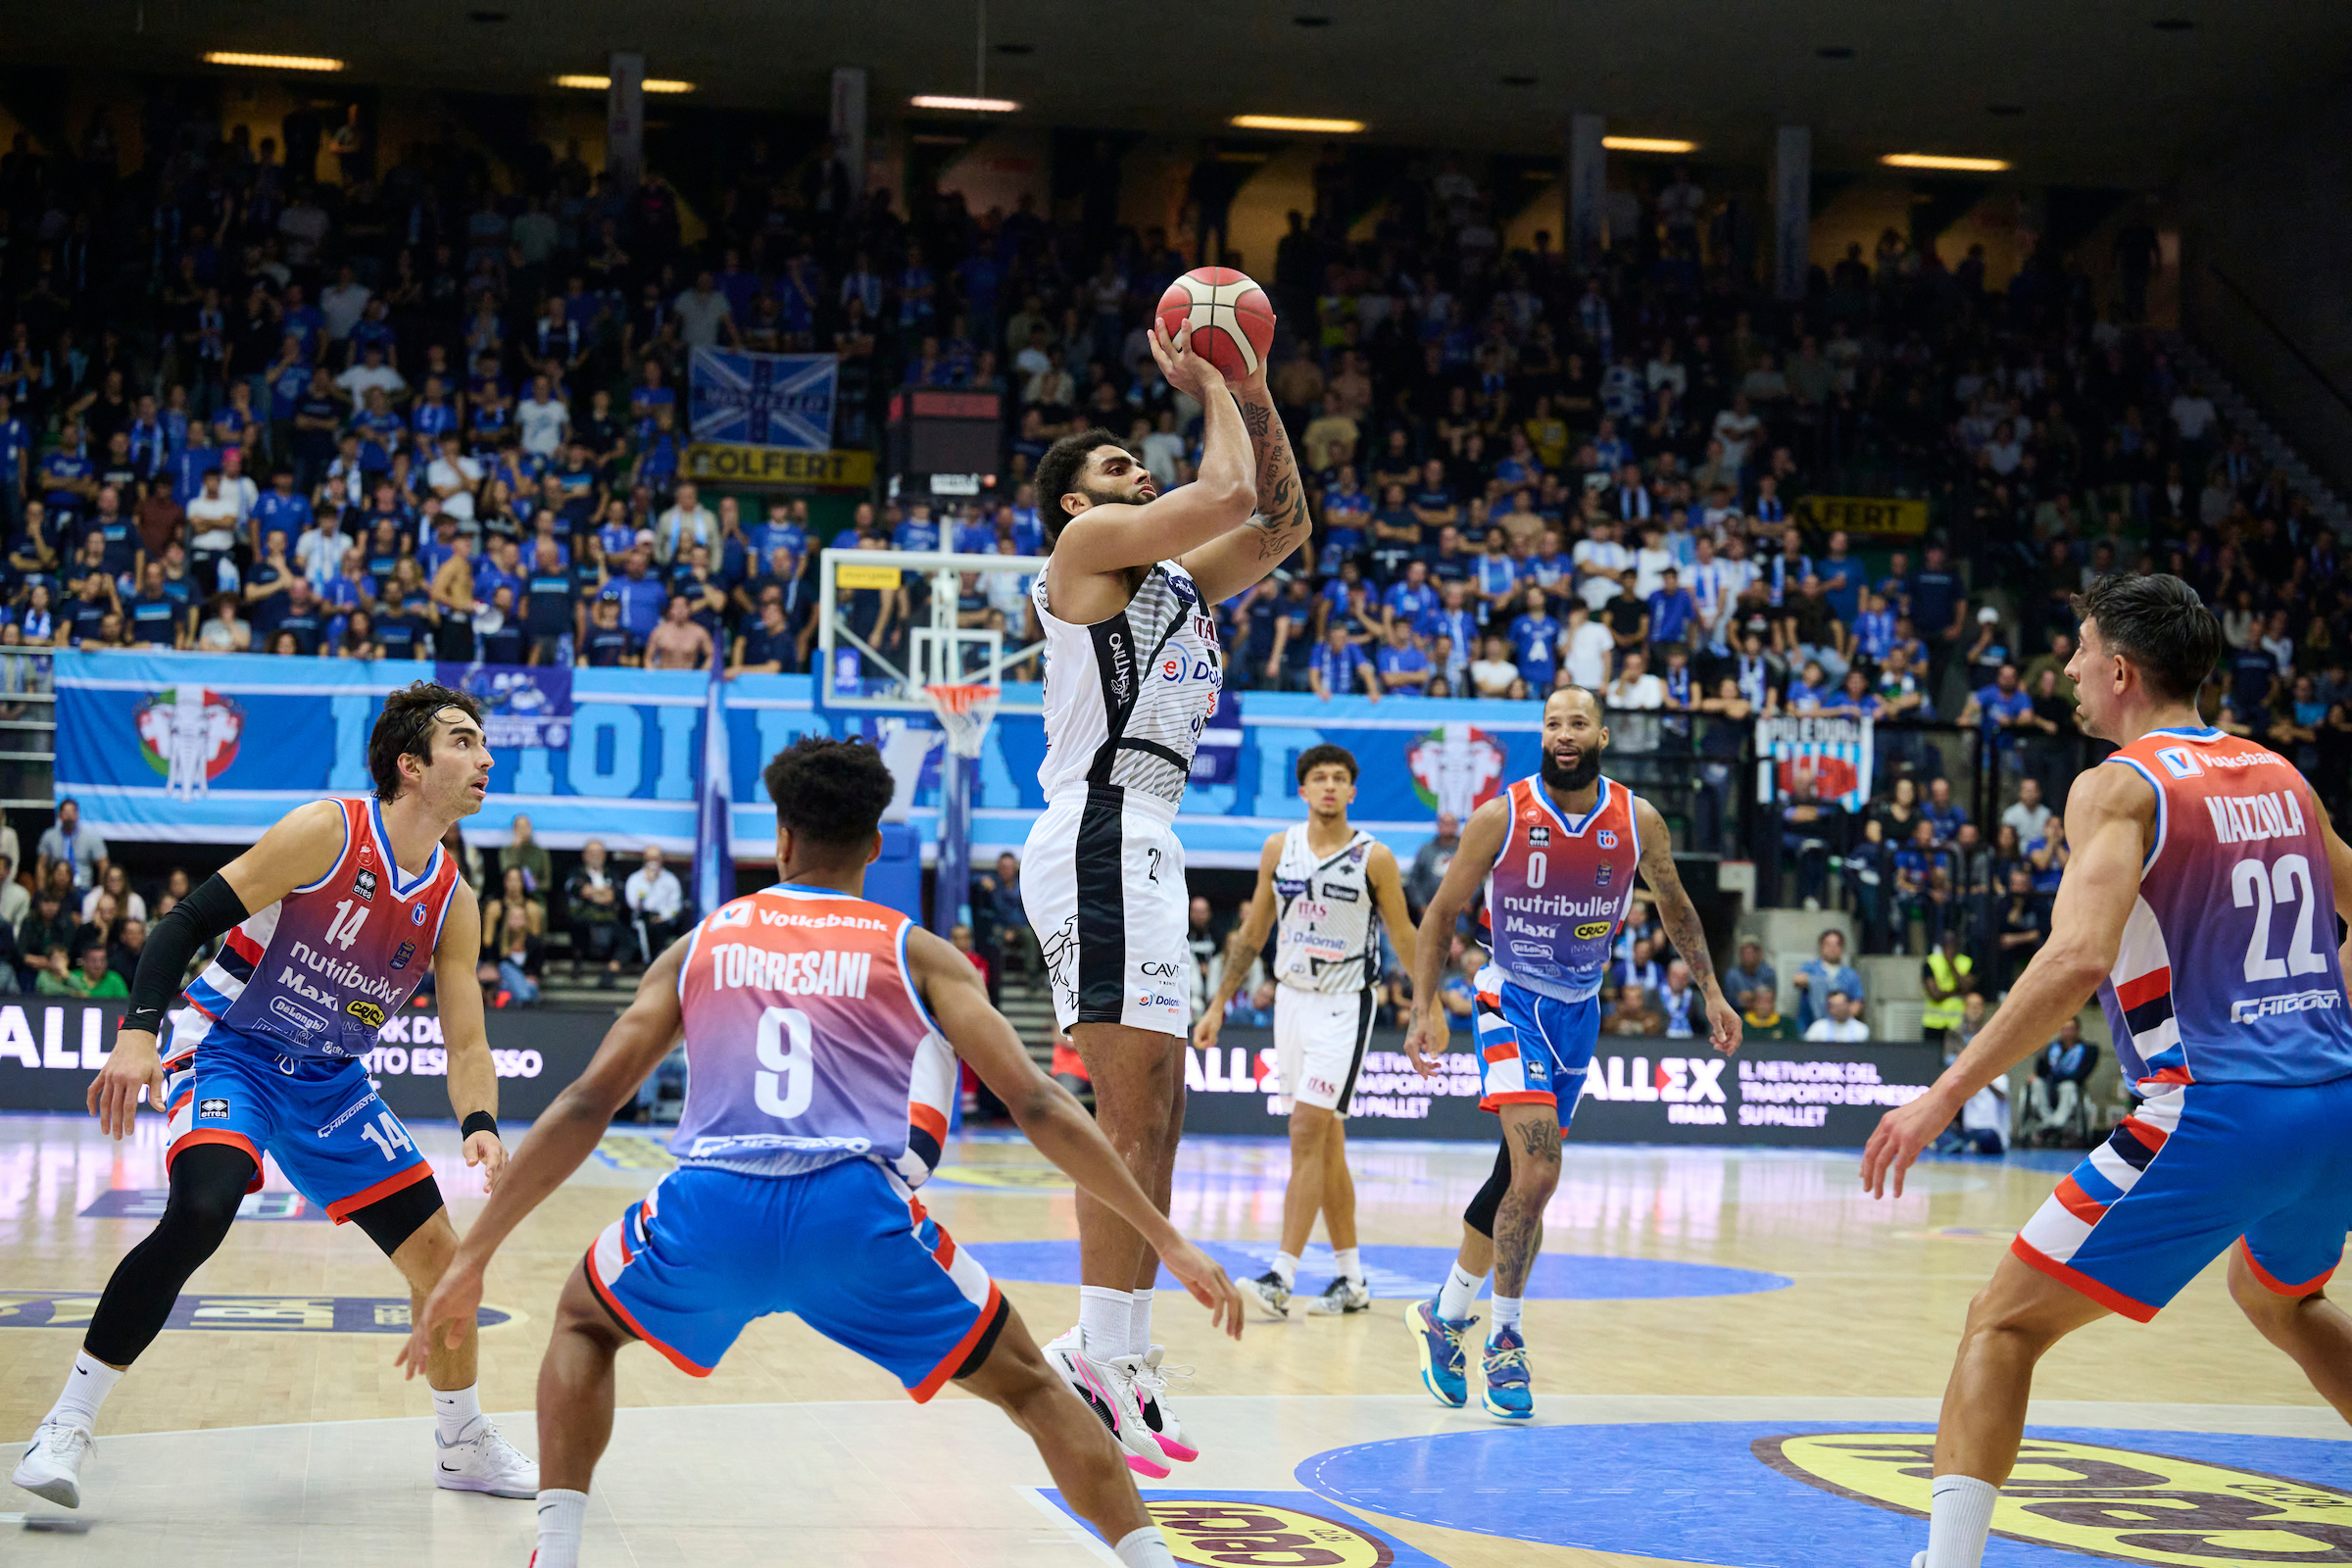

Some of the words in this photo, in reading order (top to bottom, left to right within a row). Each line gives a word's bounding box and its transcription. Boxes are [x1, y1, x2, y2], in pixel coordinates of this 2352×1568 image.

[1194, 615, 1218, 644] ITA
[2204, 790, 2306, 844] MAZZOLA
[354, 884, 372, 900] errea
[1527, 852, 1547, 889] 0
[324, 899, 370, 951] 14
[760, 908, 888, 932] Volksbank
[1504, 895, 1620, 917] nutribullet
[1505, 915, 1561, 939] Maxi
[2231, 854, 2328, 983] 22
[710, 943, 871, 1000] TORRESANI
[754, 1005, 813, 1119] 9
[1581, 1056, 1727, 1103] ALLEX
[201, 1110, 227, 1119] errea
[318, 1093, 376, 1139] CHIGGIATO
[361, 1111, 413, 1162] 14
